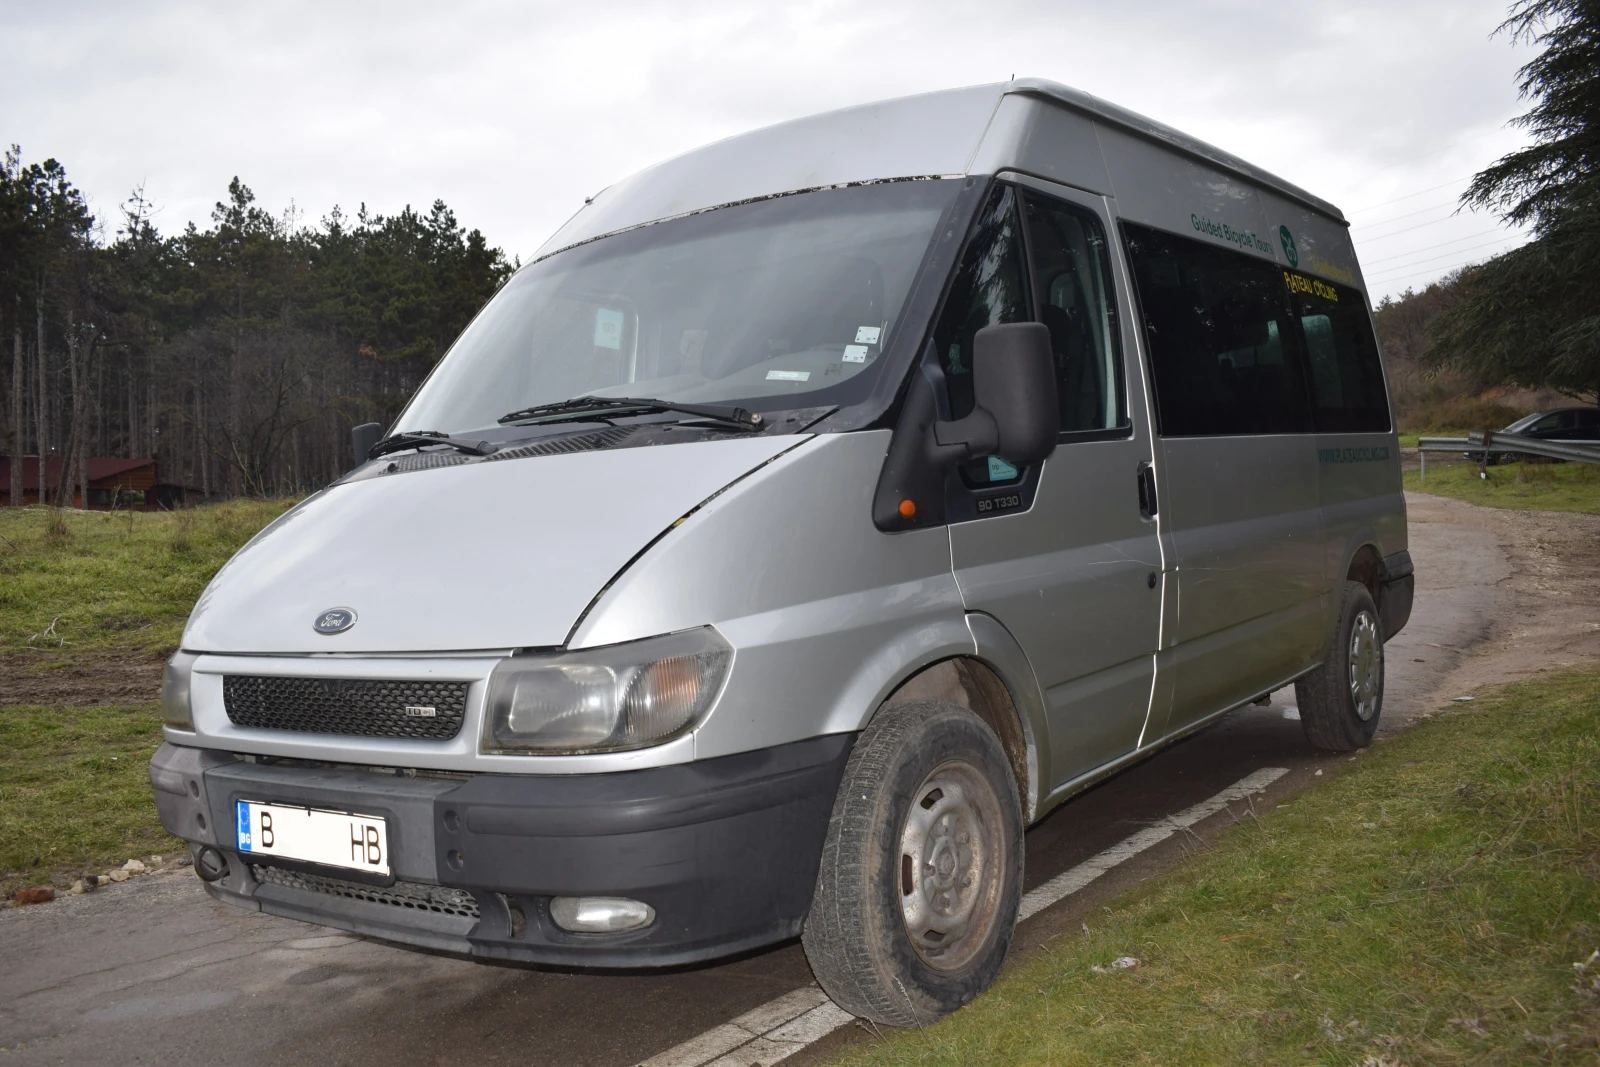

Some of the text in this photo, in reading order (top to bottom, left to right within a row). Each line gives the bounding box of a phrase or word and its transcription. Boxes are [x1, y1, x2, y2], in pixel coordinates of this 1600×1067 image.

[1191, 213, 1274, 255] Guided Bicycle Tours
[1283, 271, 1338, 302] PLATEAU CYCLING
[978, 495, 1019, 512] 90 T330
[320, 613, 345, 627] Ford
[240, 833, 251, 845] BG
[260, 811, 382, 866] B HB
